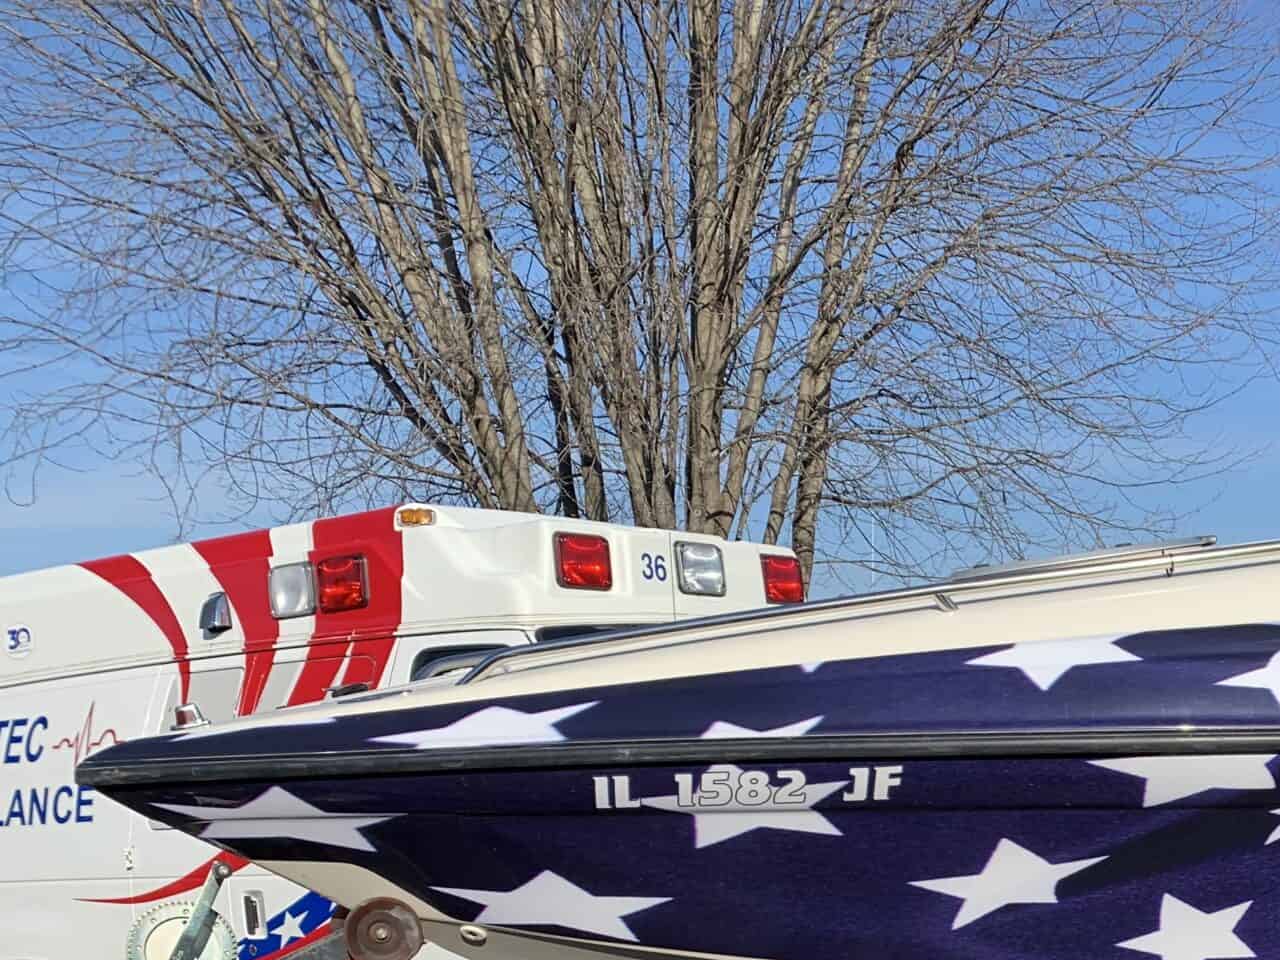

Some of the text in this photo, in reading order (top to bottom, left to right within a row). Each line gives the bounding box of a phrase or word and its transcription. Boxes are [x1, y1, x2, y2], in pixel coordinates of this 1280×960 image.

[641, 553, 667, 581] 36
[0, 785, 95, 827] ANCE
[593, 765, 903, 808] IL 1582 JF
